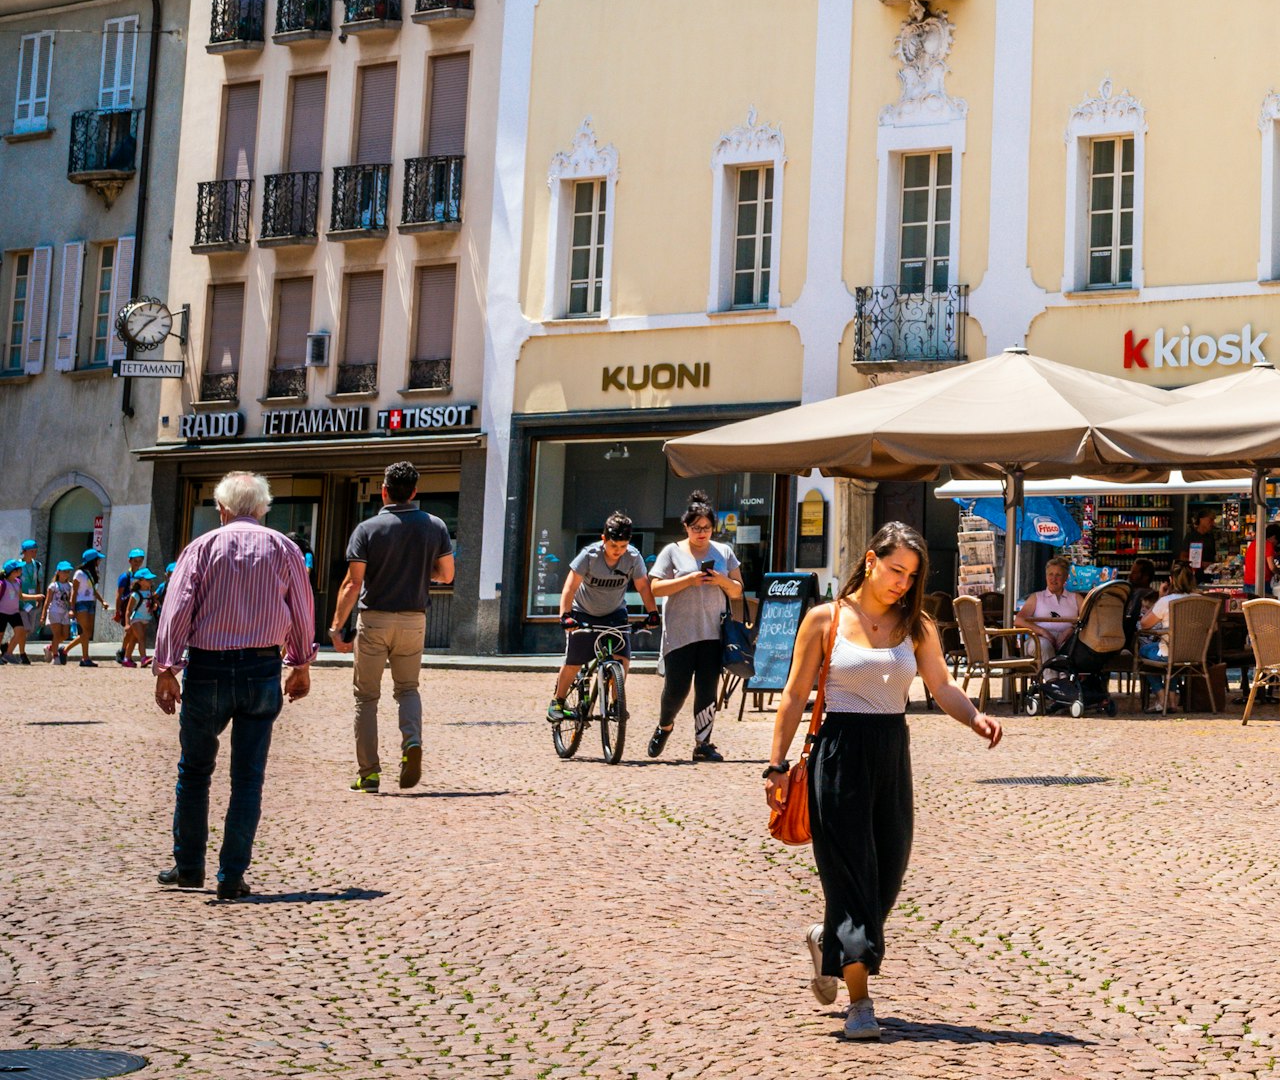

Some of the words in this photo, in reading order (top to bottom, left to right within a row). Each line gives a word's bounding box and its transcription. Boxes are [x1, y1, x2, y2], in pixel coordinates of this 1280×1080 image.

[1153, 322, 1268, 367] kiosk
[121, 362, 182, 375] TETTAMANTI
[601, 362, 710, 392] KUONI
[179, 411, 240, 438] RADO
[260, 406, 365, 435] TETTAMANTI
[740, 497, 765, 505] KUONI
[590, 577, 626, 588] PUMA
